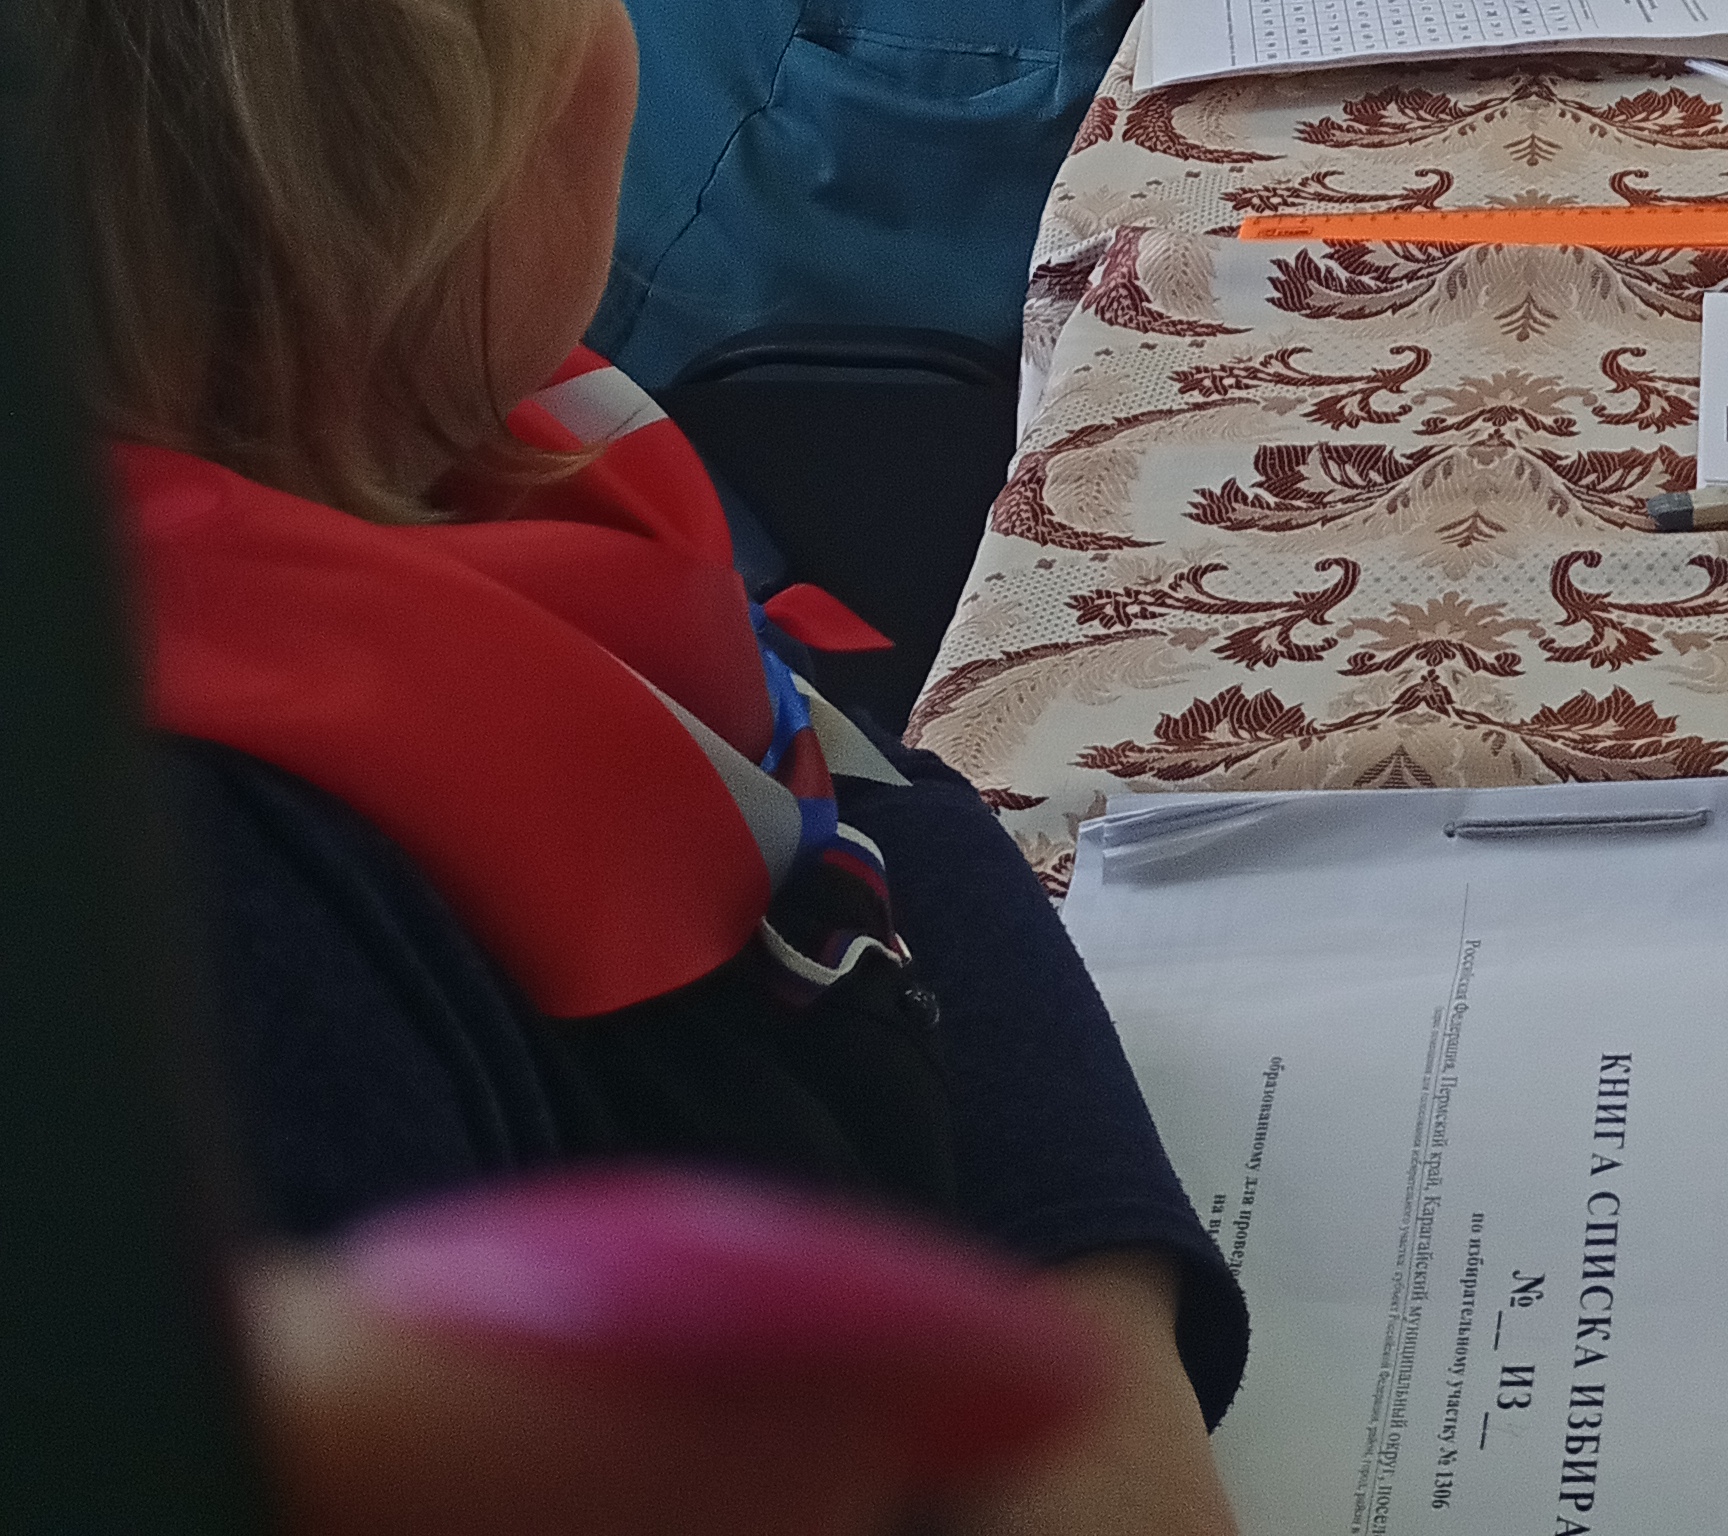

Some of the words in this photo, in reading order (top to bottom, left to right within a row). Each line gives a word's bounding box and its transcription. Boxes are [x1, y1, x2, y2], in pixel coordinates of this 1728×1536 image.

[1455, 939, 1481, 998] Российская
[1247, 1057, 1285, 1171] образованному
[1433, 1077, 1459, 1146] Пермский
[1588, 1053, 1632, 1176] КНИГА
[1242, 1177, 1259, 1205] для
[1423, 1152, 1446, 1190] край,
[1211, 1194, 1228, 1213] на
[1469, 1213, 1485, 1233] по
[1409, 1196, 1442, 1301] Карагайский
[1450, 1238, 1484, 1375] избирательному
[1572, 1192, 1621, 1368] СПИСКА
[1391, 1306, 1422, 1428] муниципальный
[1496, 1365, 1535, 1410] ИЗ
[1438, 1380, 1463, 1442] участку
[1437, 1447, 1458, 1466] №
[1431, 1472, 1454, 1509] 1306
